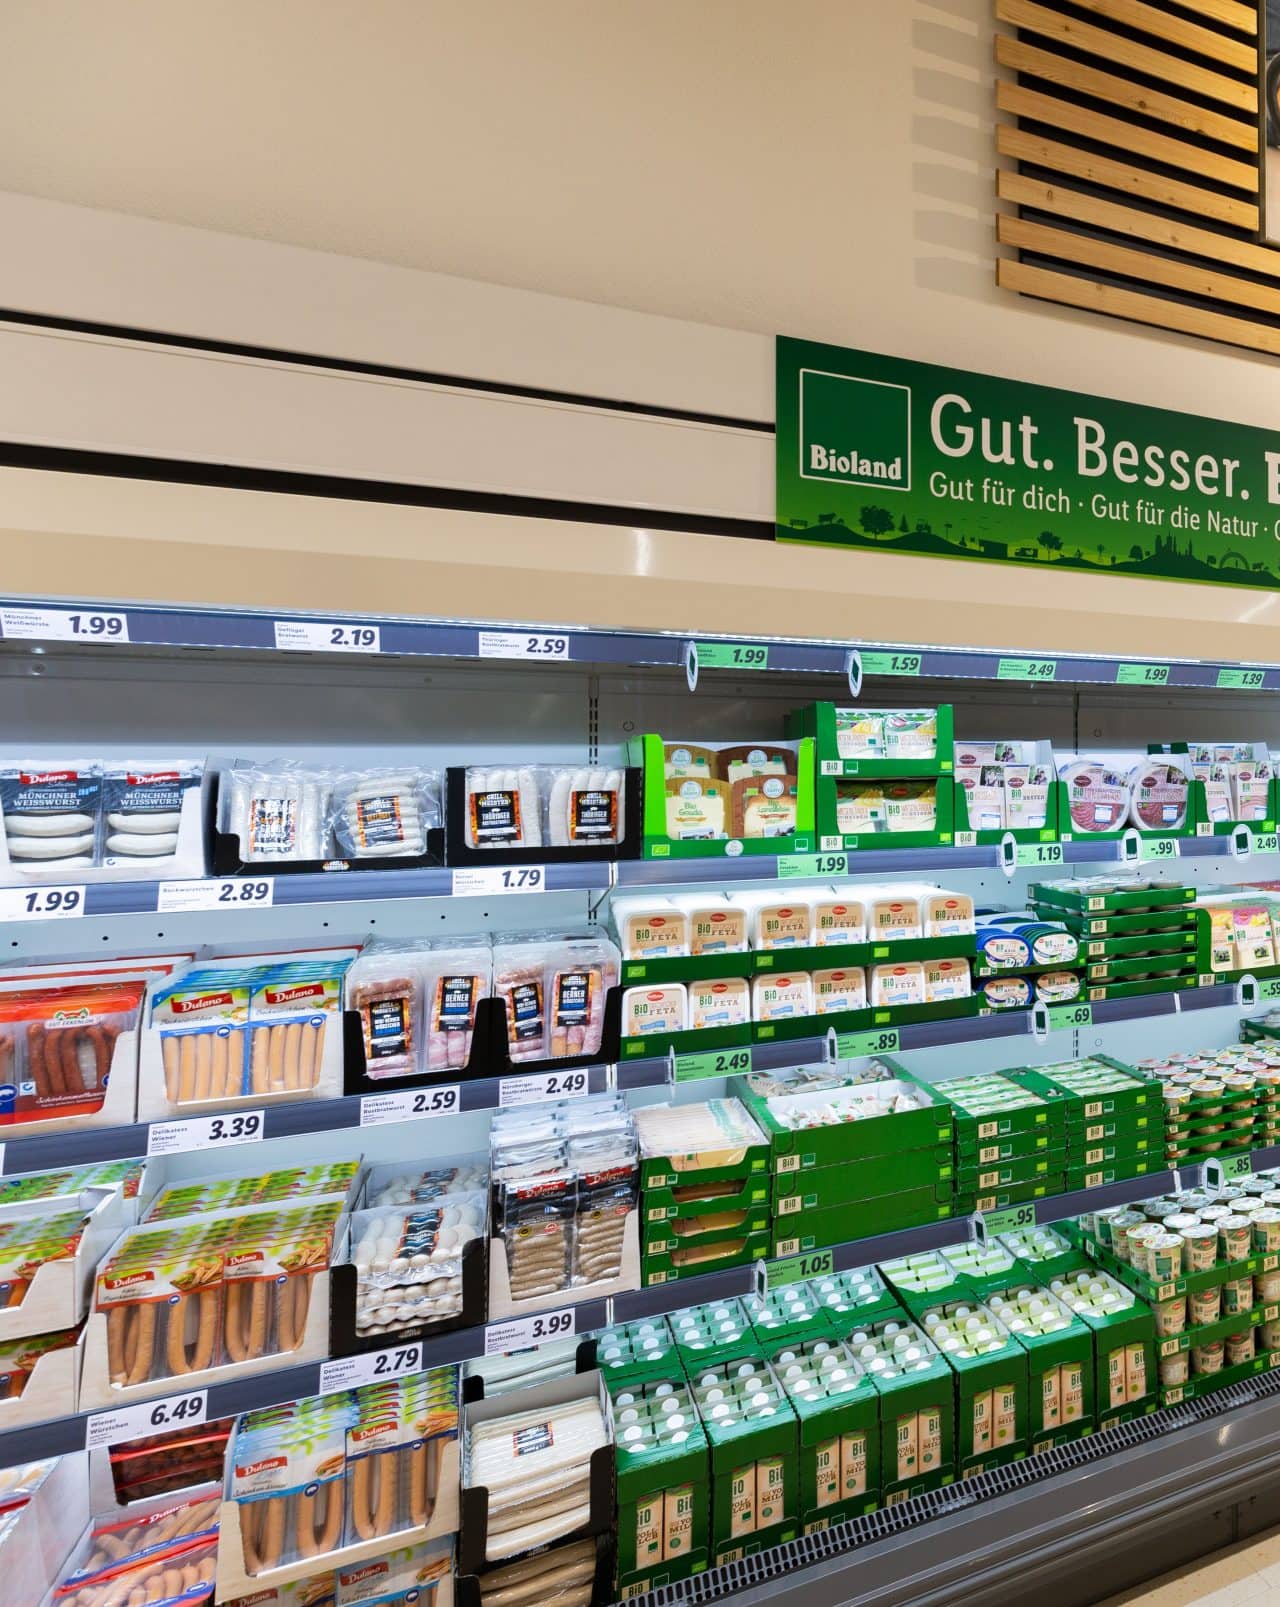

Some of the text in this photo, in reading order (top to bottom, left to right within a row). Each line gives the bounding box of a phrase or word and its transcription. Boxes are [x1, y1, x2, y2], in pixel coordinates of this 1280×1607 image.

[930, 394, 1053, 471] Gut.
[1074, 417, 1249, 500] Besser.
[810, 444, 901, 480] Bioland
[930, 472, 974, 501] Gut
[983, 478, 1015, 506] für
[1023, 485, 1070, 513] dich
[1092, 494, 1129, 521] Gut
[1136, 500, 1164, 526] für
[1171, 505, 1200, 530] die
[1207, 510, 1258, 537] Natur
[69, 615, 122, 635] 1.99
[330, 628, 375, 645] 2.19
[527, 638, 565, 653] 2.59
[732, 649, 765, 663] 1.99
[890, 657, 918, 670] 1.59
[1027, 664, 1053, 676] 2.49
[1144, 669, 1167, 680] 1.99
[1242, 673, 1262, 685] 1.39
[30, 774, 68, 785] Dulano
[13, 799, 81, 807] WEISSWURST
[18, 792, 77, 800] MÜNCHNER
[125, 792, 179, 800] MÜNCHNER
[888, 805, 900, 814] BiO
[1150, 841, 1173, 855] -.99
[1257, 837, 1277, 849] 2.49
[1037, 846, 1061, 860] 1.19
[815, 857, 845, 873] 1.99
[502, 869, 540, 888] 1.79
[219, 883, 269, 901] 2.89
[25, 891, 80, 912] 1.99
[821, 917, 856, 928] BiO FETA
[879, 914, 891, 925] BiO
[936, 910, 946, 921] BiO
[698, 924, 711, 934] BiO
[767, 920, 803, 931] BiO FETA
[636, 929, 677, 941] BiO FETA
[820, 983, 832, 993] BiO
[275, 989, 315, 1003] Dulano
[713, 999, 738, 1007] FETA
[182, 997, 222, 1011] Dulano
[634, 1004, 676, 1015] BiO FETA
[1065, 1008, 1089, 1022] -.69
[867, 1033, 897, 1049] -.89
[715, 1053, 749, 1071] 2.49
[546, 1074, 585, 1094] 2.49
[412, 1090, 456, 1112] 2.59
[152, 1126, 188, 1136] Delikatess
[208, 1115, 260, 1140] 3.39
[982, 1123, 994, 1135] BiO
[152, 1134, 177, 1142] Wiener
[783, 1158, 795, 1168] BiO
[1229, 1157, 1249, 1173] -.85
[784, 1199, 796, 1210] BiO
[1008, 1207, 1033, 1225] -.95
[783, 1242, 794, 1252] BiO
[231, 1254, 258, 1266] Dulano
[799, 1254, 830, 1275] 1.05
[113, 1273, 147, 1288] Dulano
[532, 1313, 571, 1337] 3.99
[374, 1348, 418, 1375] 2.79
[150, 1397, 202, 1425] 6.49
[90, 1418, 116, 1428] Wiener
[90, 1421, 128, 1435] Würstchen
[361, 1425, 391, 1439] Dulano
[817, 1452, 829, 1468] iO
[246, 1460, 279, 1476] Dulano
[733, 1480, 744, 1495] iO
[640, 1509, 651, 1525] iO
[722, 1551, 736, 1564] BiO
[349, 1566, 381, 1582] Dulano
[629, 1584, 642, 1596] BiO
